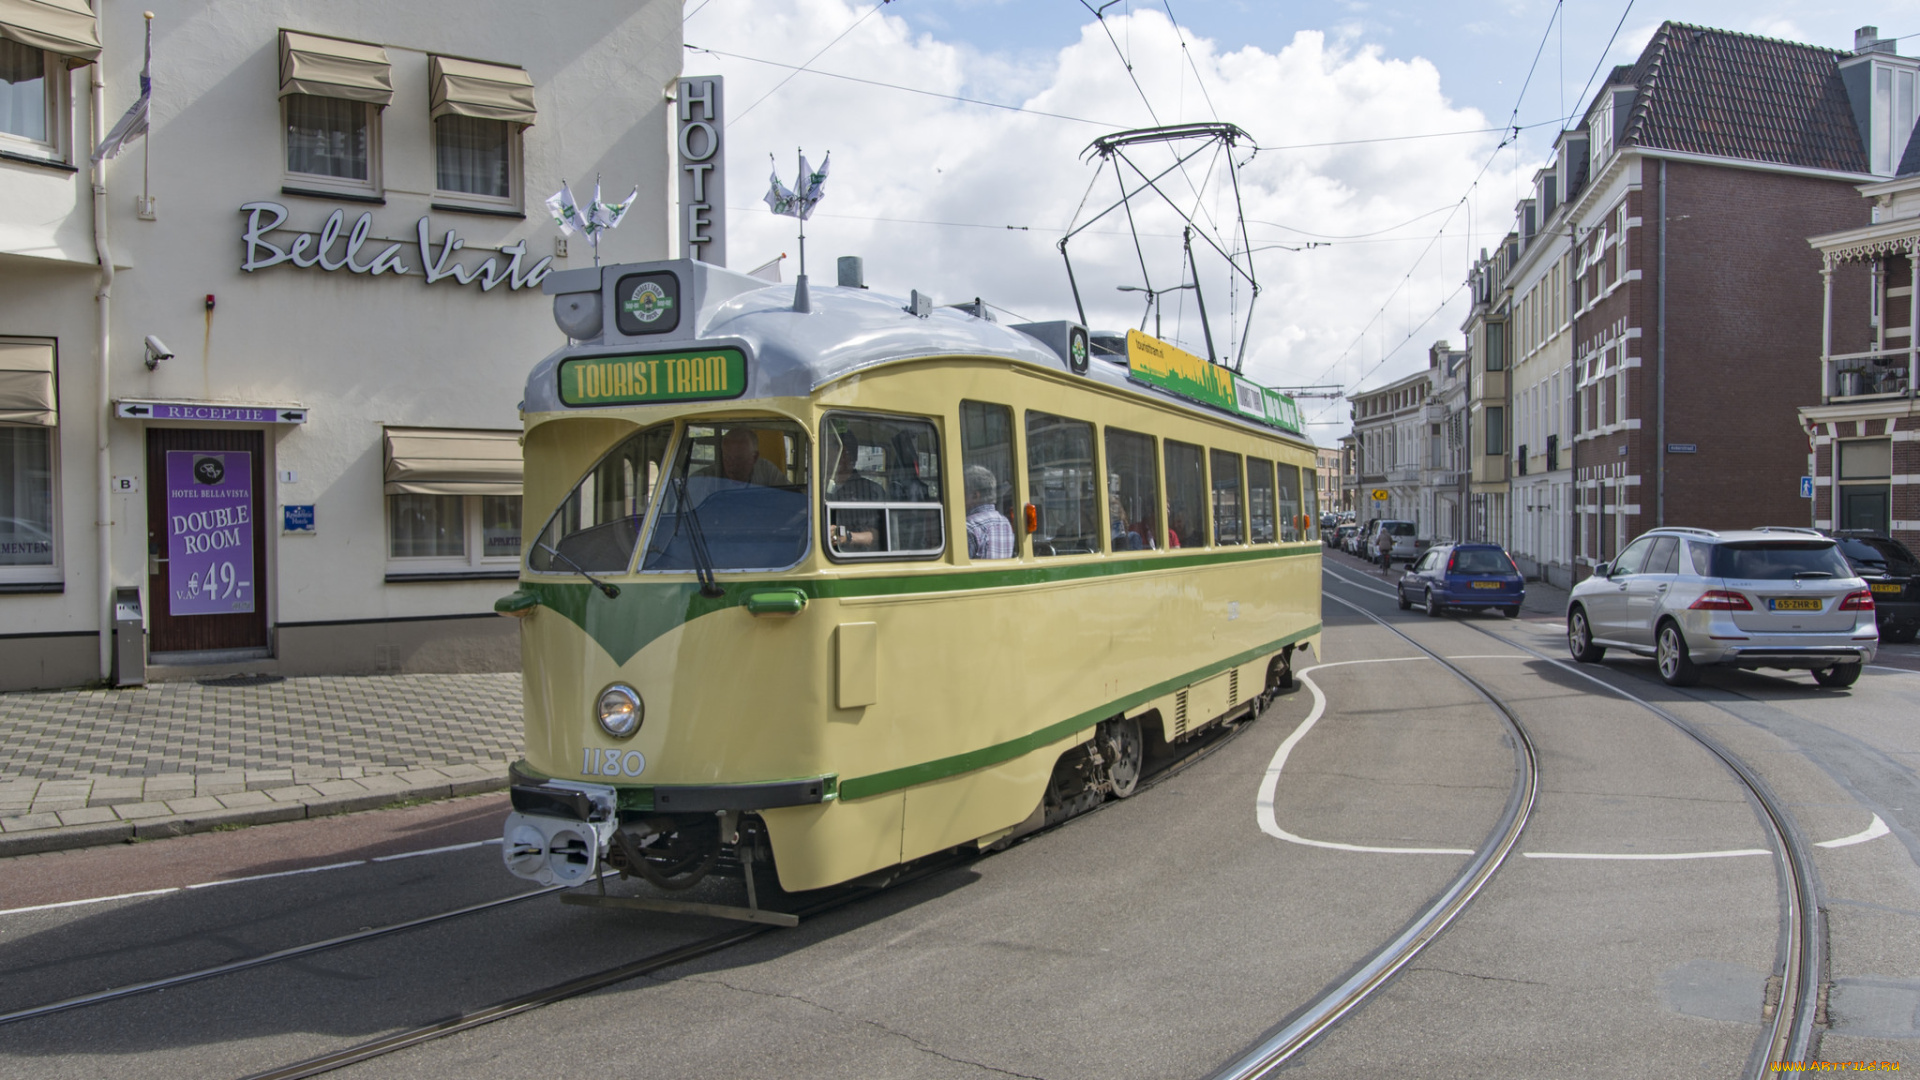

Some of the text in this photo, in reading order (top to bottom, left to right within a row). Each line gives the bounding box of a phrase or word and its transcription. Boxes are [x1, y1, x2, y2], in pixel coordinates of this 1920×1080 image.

[240, 201, 409, 276] Bella
[416, 215, 555, 292] Vista
[574, 356, 728, 399] TOURIST TRAM
[168, 406, 264, 421] RECEPTIE
[120, 479, 131, 490] B
[287, 471, 292, 481] 1
[171, 489, 199, 498] HOTEL
[172, 505, 249, 535] DOUBLE
[184, 528, 241, 555] ROOM
[1777, 600, 1820, 609] 65-ZHR-8
[581, 747, 646, 777] 1180
